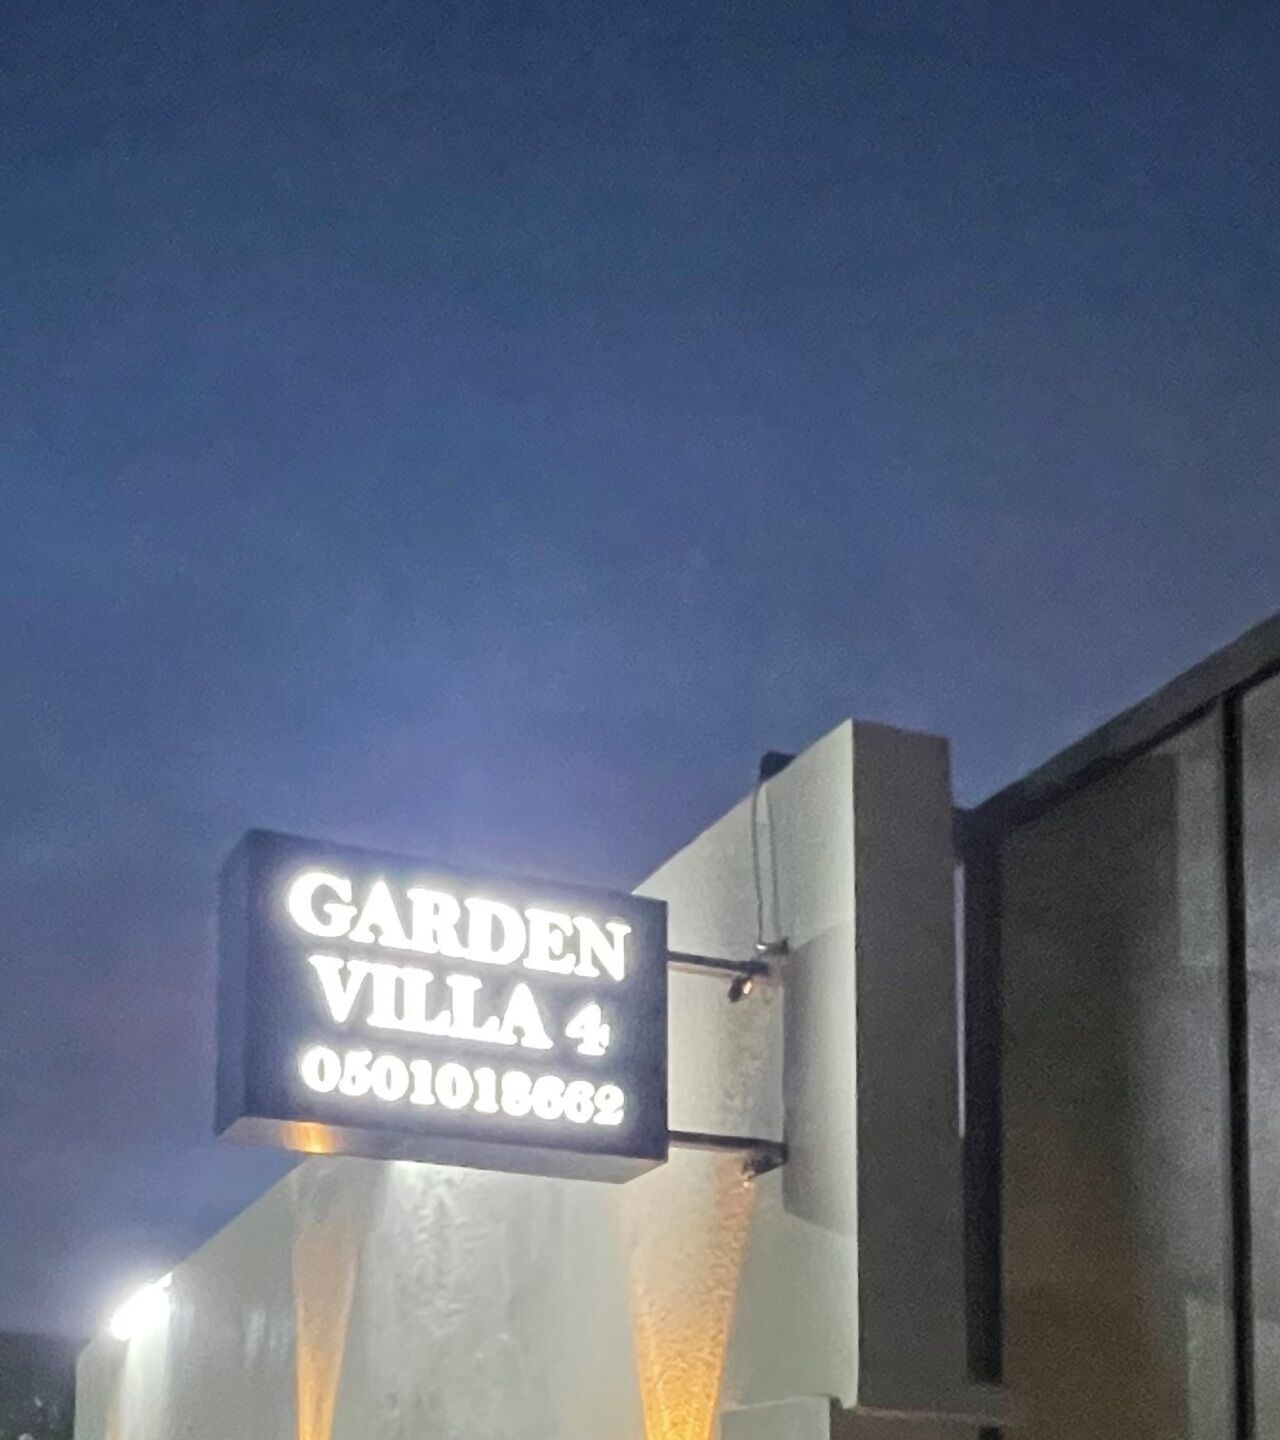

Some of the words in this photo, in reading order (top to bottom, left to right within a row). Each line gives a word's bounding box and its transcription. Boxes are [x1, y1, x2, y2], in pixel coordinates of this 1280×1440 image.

[287, 871, 631, 981] GARDEN
[308, 955, 553, 1049] VILLA
[565, 1002, 611, 1056] 4
